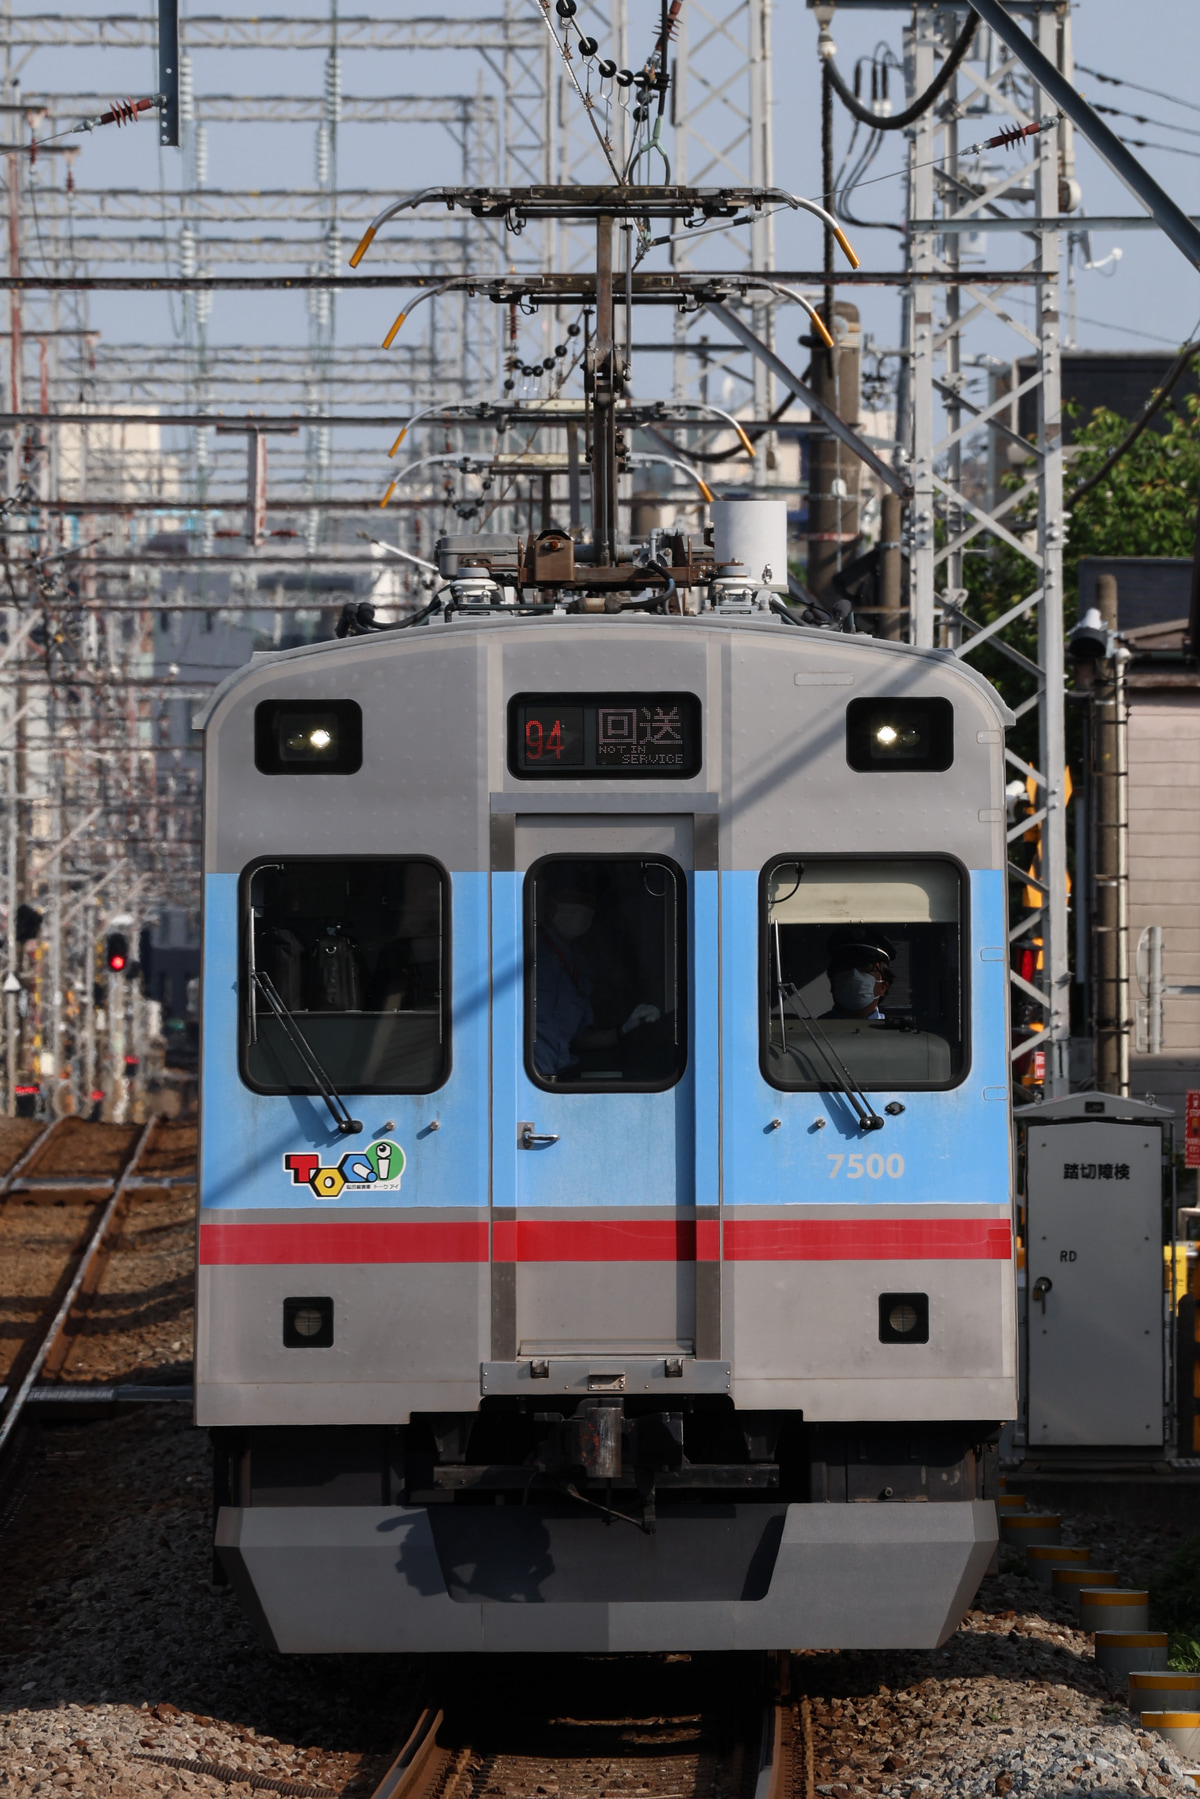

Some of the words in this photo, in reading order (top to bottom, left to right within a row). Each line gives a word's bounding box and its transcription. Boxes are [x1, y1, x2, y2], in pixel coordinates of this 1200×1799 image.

[599, 707, 683, 744] 回送
[525, 720, 564, 760] 94
[599, 745, 627, 754] NOT
[631, 745, 646, 754] IN
[622, 754, 684, 764] SERVICE
[827, 1153, 905, 1179] 7500
[1063, 1163, 1130, 1180] 踏切障検
[1060, 1250, 1077, 1263] RD
